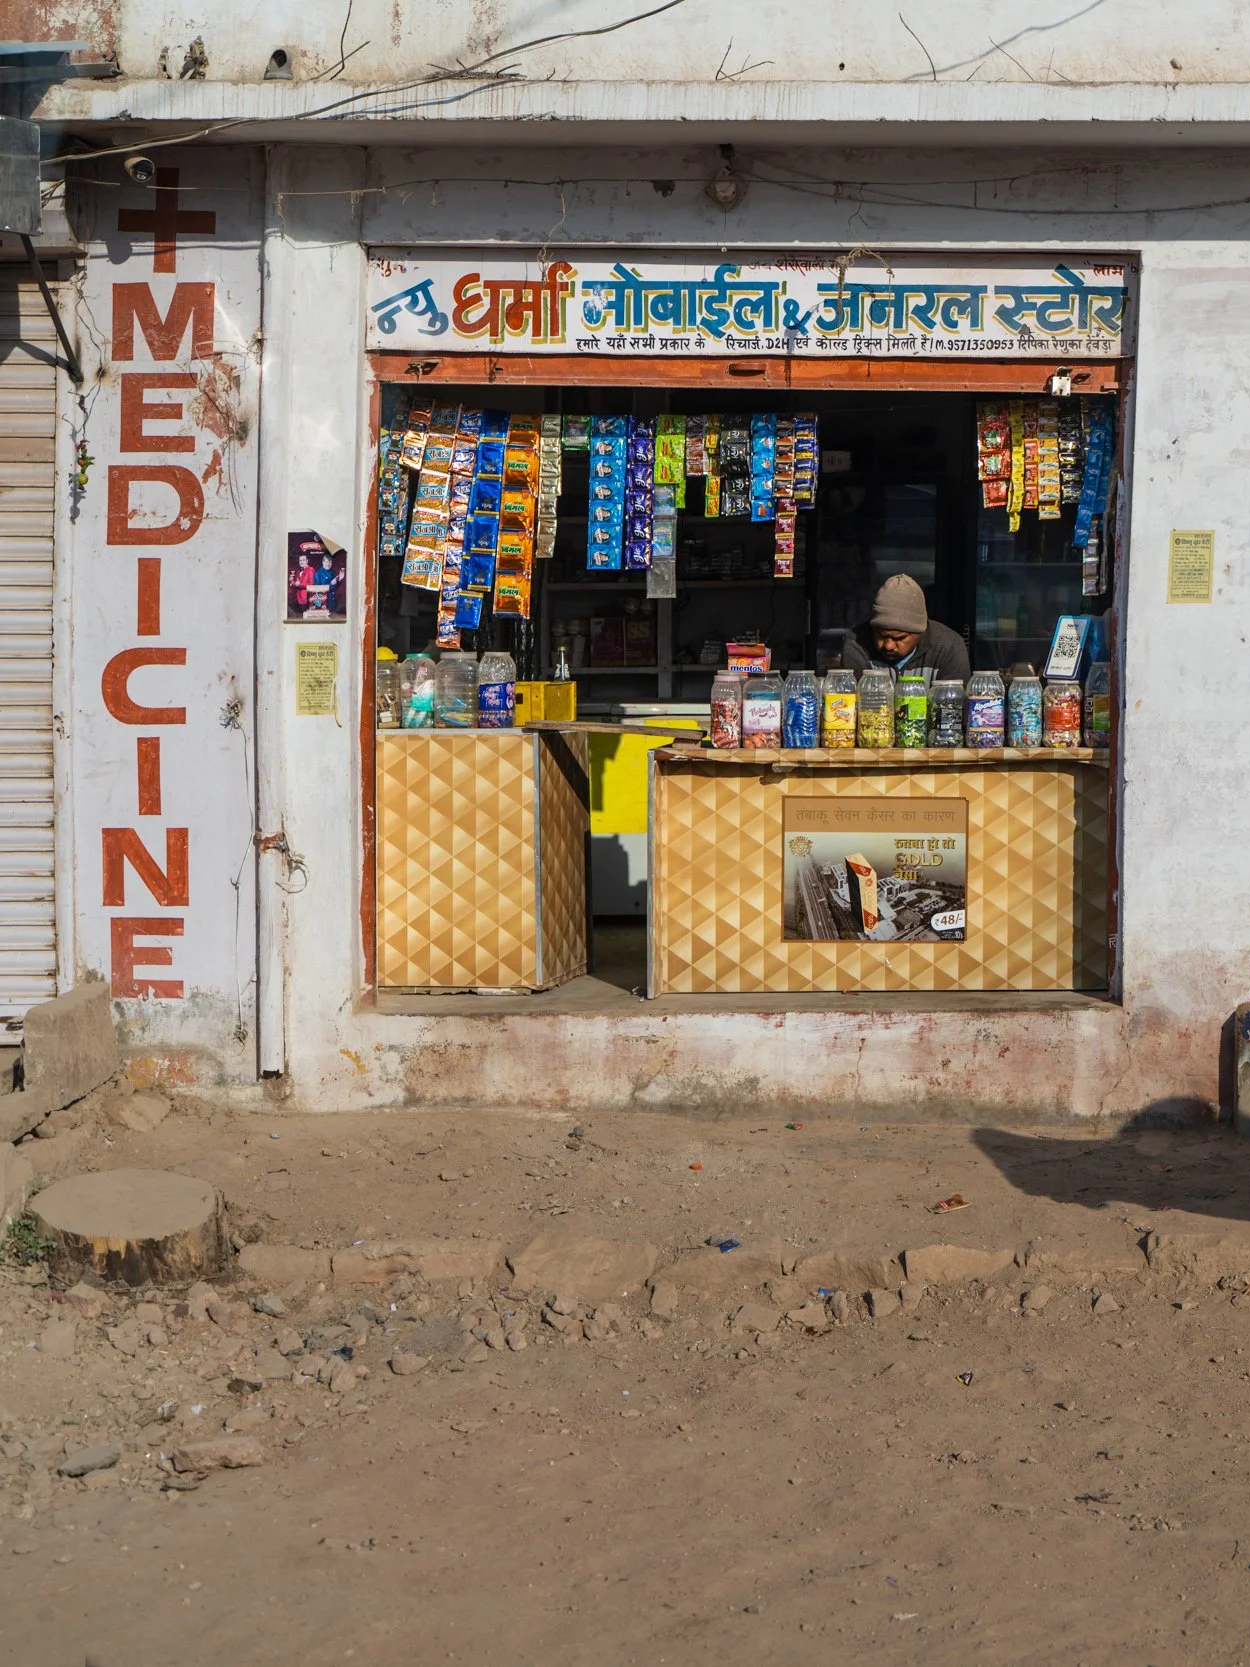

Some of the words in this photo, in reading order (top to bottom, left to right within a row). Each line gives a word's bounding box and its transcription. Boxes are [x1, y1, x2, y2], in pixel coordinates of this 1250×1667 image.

[581, 262, 782, 338] मोबाईल
[783, 298, 812, 334] &
[814, 281, 988, 333] जनरल
[994, 263, 1128, 333] स्टोर
[576, 334, 601, 351] हमारे
[629, 334, 655, 350] सभी
[659, 337, 690, 351] प्रकार
[694, 333, 706, 350] के
[100, 281, 215, 999] MEDICINE
[730, 664, 763, 672] mentos
[834, 807, 861, 821] सेवन
[902, 811, 916, 822] का
[922, 811, 955, 822] कारण
[926, 836, 939, 851] हो
[942, 837, 956, 850] तो
[894, 853, 943, 867] GOLD
